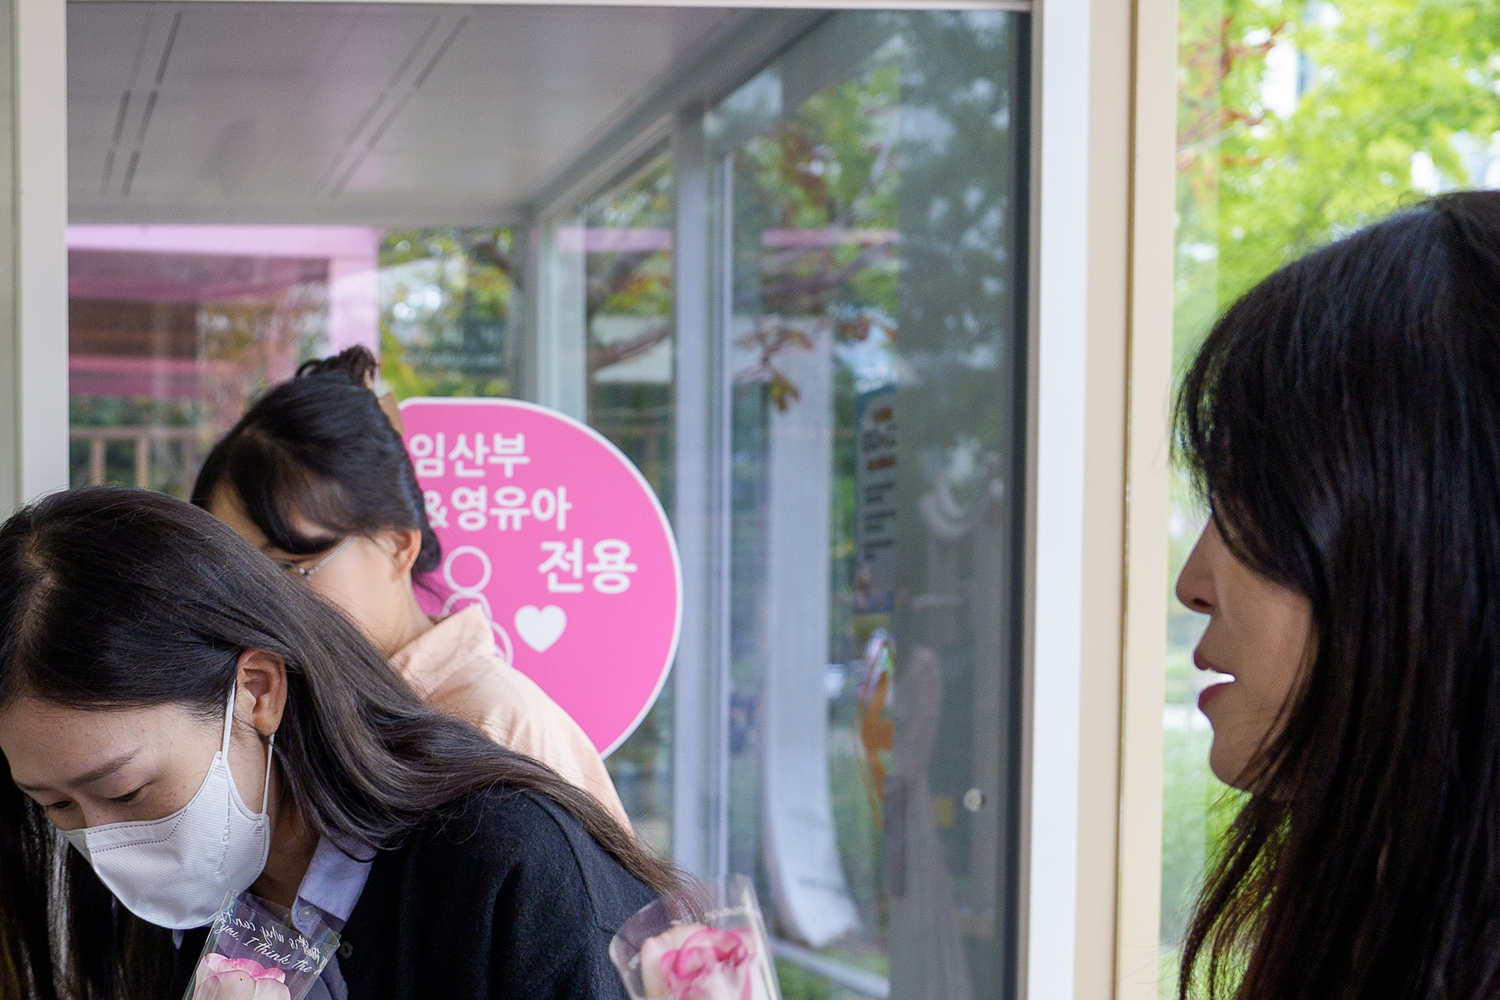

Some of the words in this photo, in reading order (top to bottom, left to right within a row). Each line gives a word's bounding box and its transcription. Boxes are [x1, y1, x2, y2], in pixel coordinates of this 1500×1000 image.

[409, 432, 530, 478] 임산부
[424, 484, 573, 532] &영유아
[537, 537, 638, 594] 전용
[243, 937, 259, 947] I
[254, 942, 290, 965] think
[292, 959, 312, 973] the
